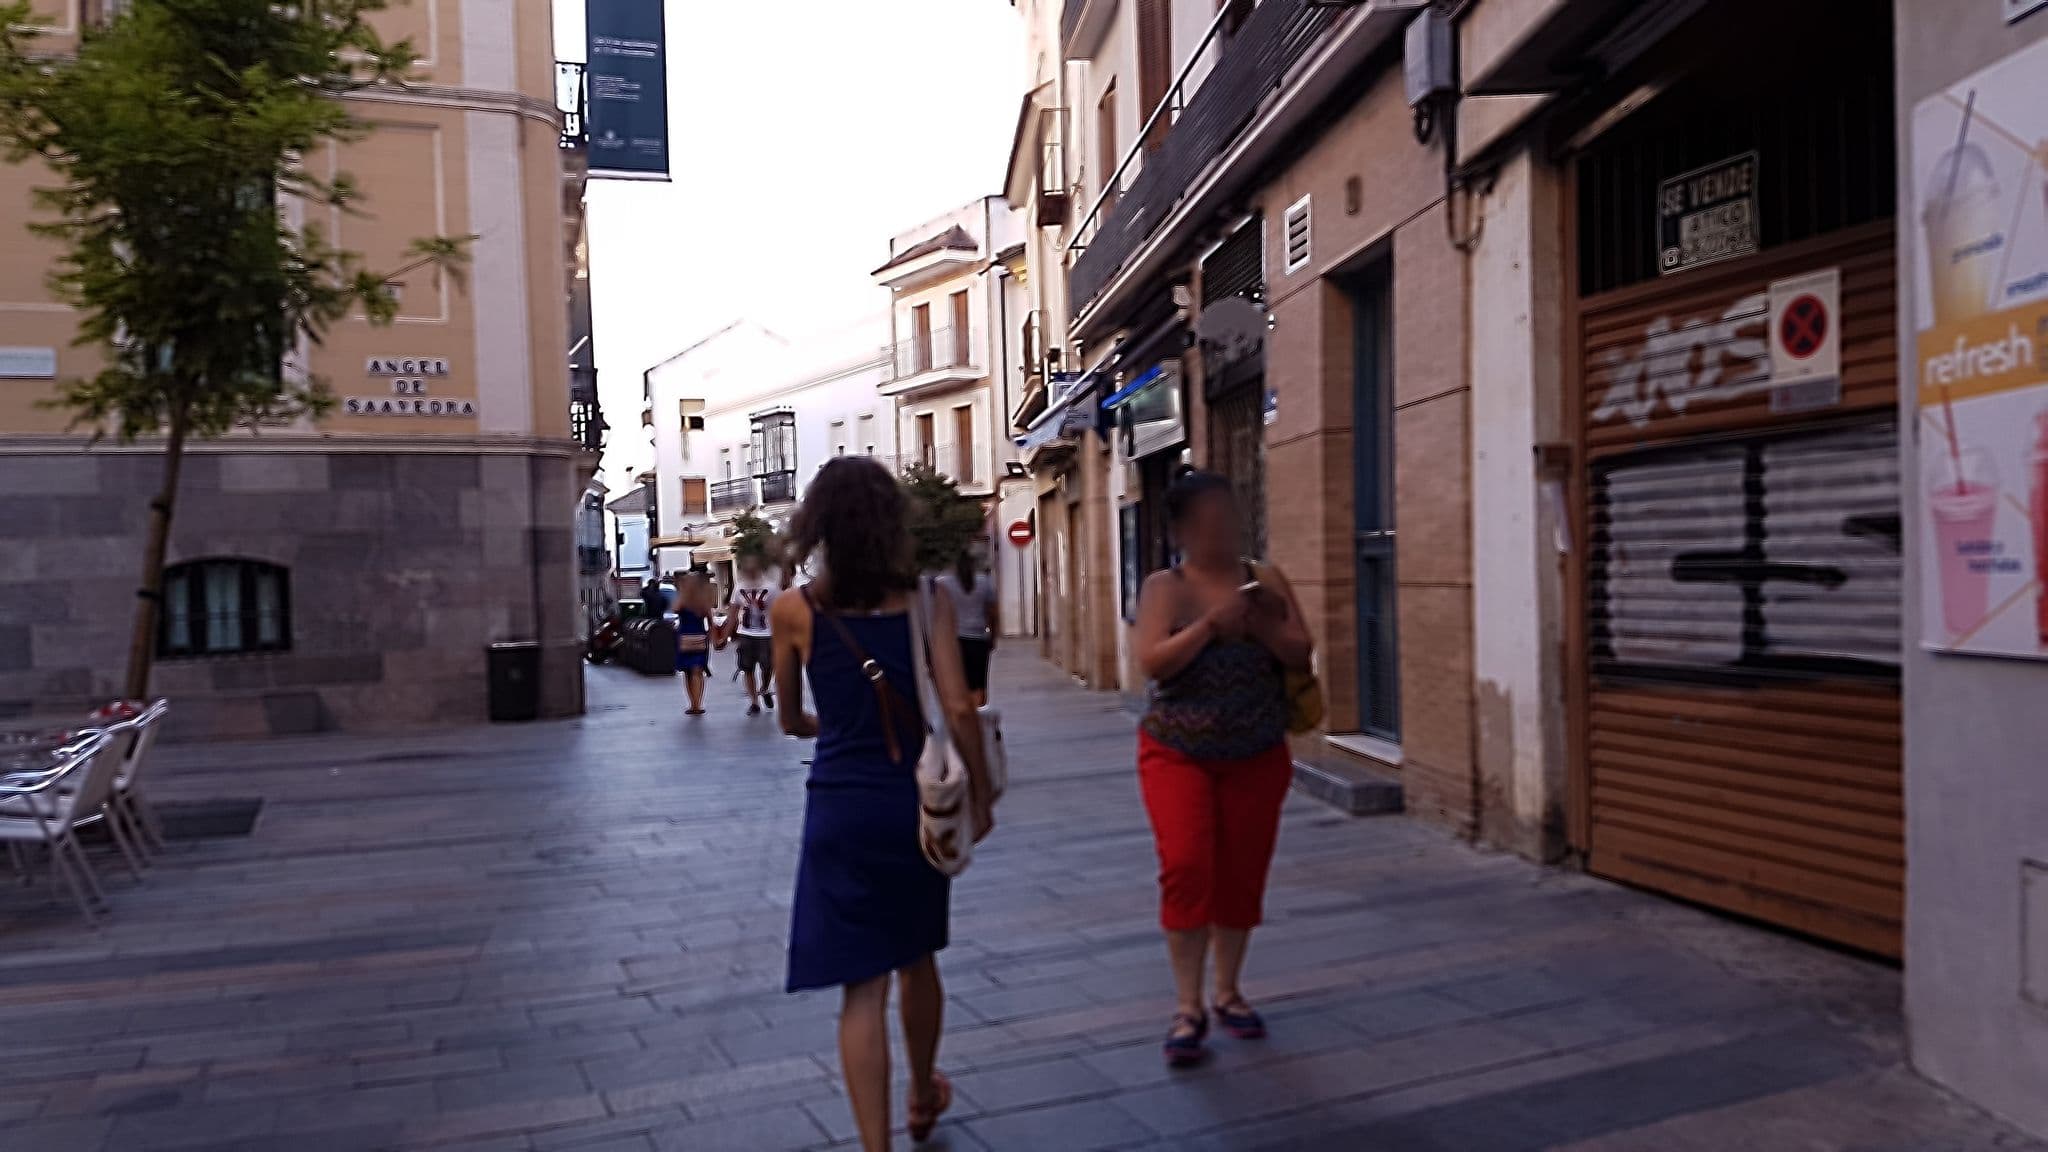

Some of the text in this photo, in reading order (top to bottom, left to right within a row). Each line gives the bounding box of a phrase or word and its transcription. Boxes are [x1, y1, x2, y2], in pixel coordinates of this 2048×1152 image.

[1925, 321, 2034, 387] refresh
[395, 379, 425, 394] DE
[346, 399, 474, 415] SAAVEDRA
